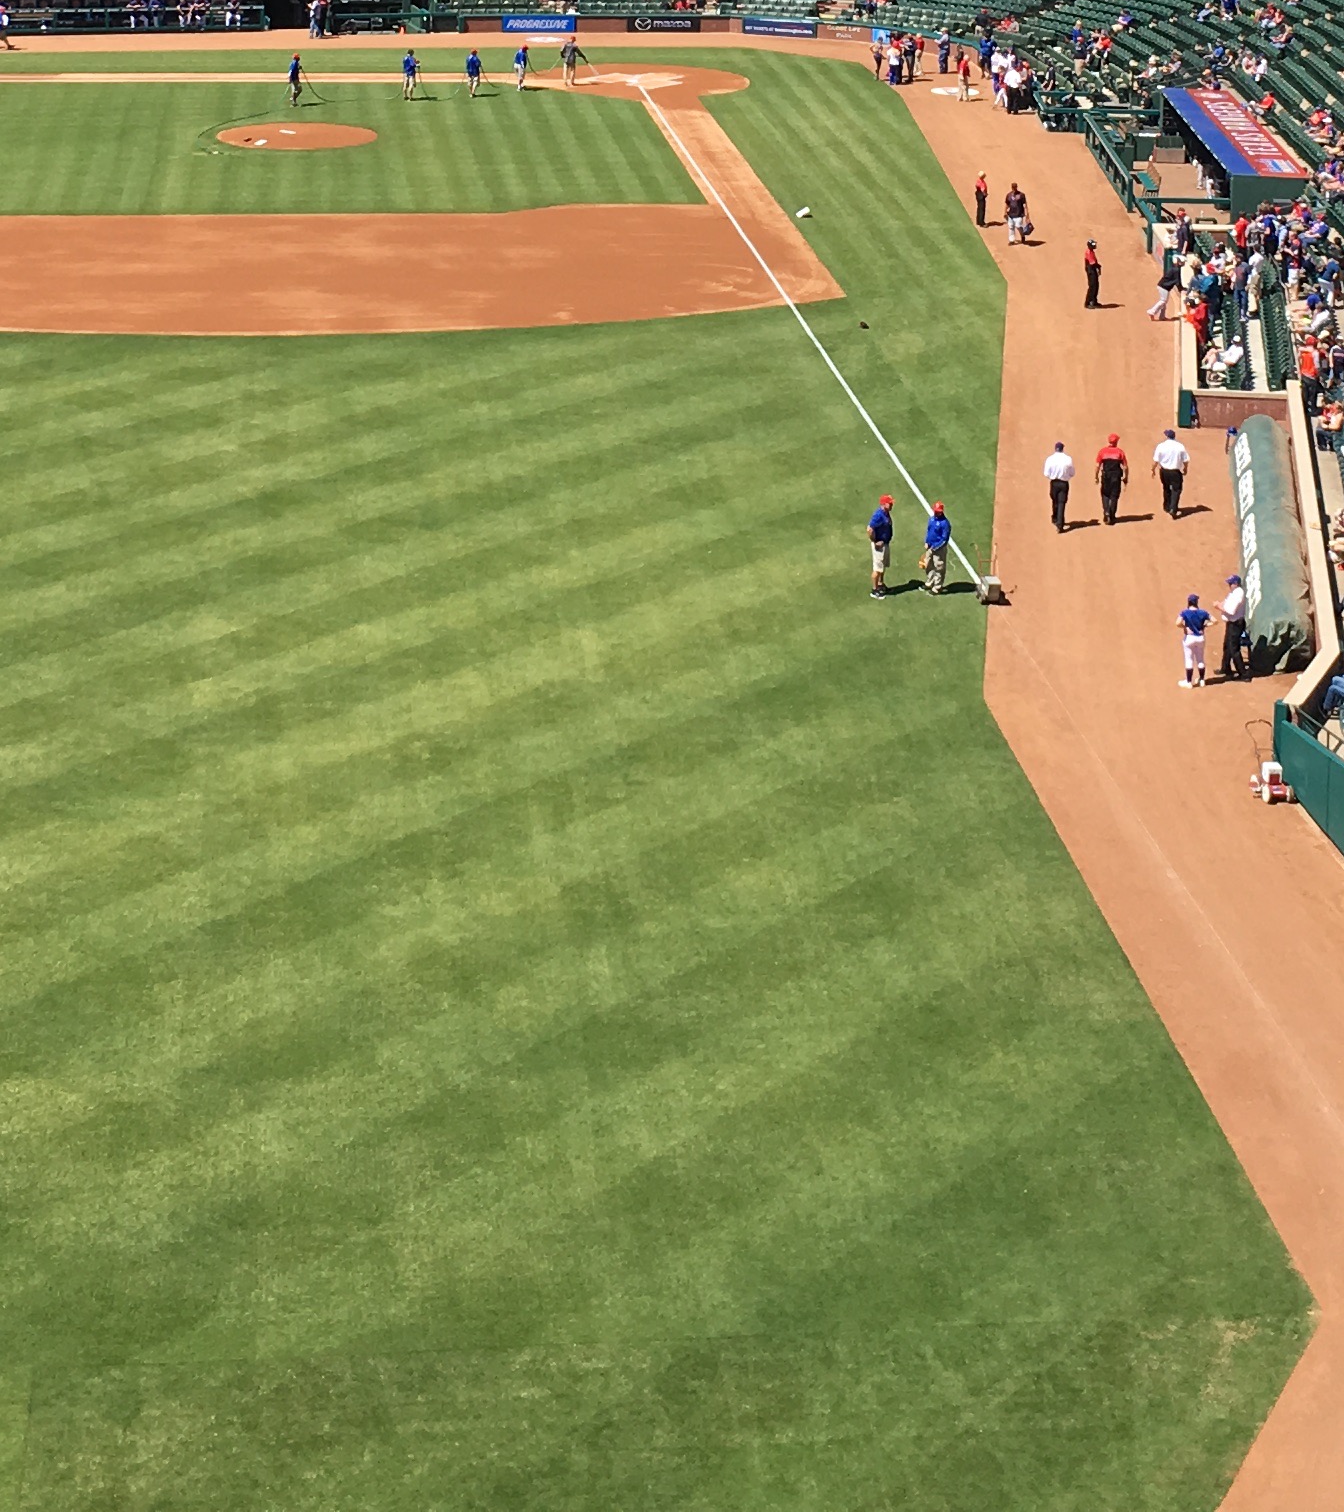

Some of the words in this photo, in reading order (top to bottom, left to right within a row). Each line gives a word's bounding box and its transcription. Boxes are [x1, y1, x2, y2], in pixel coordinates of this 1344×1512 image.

[506, 19, 569, 29] PROGRESSIVE
[1203, 101, 1260, 131] RANGERS
[1231, 132, 1282, 156] TEXAS
